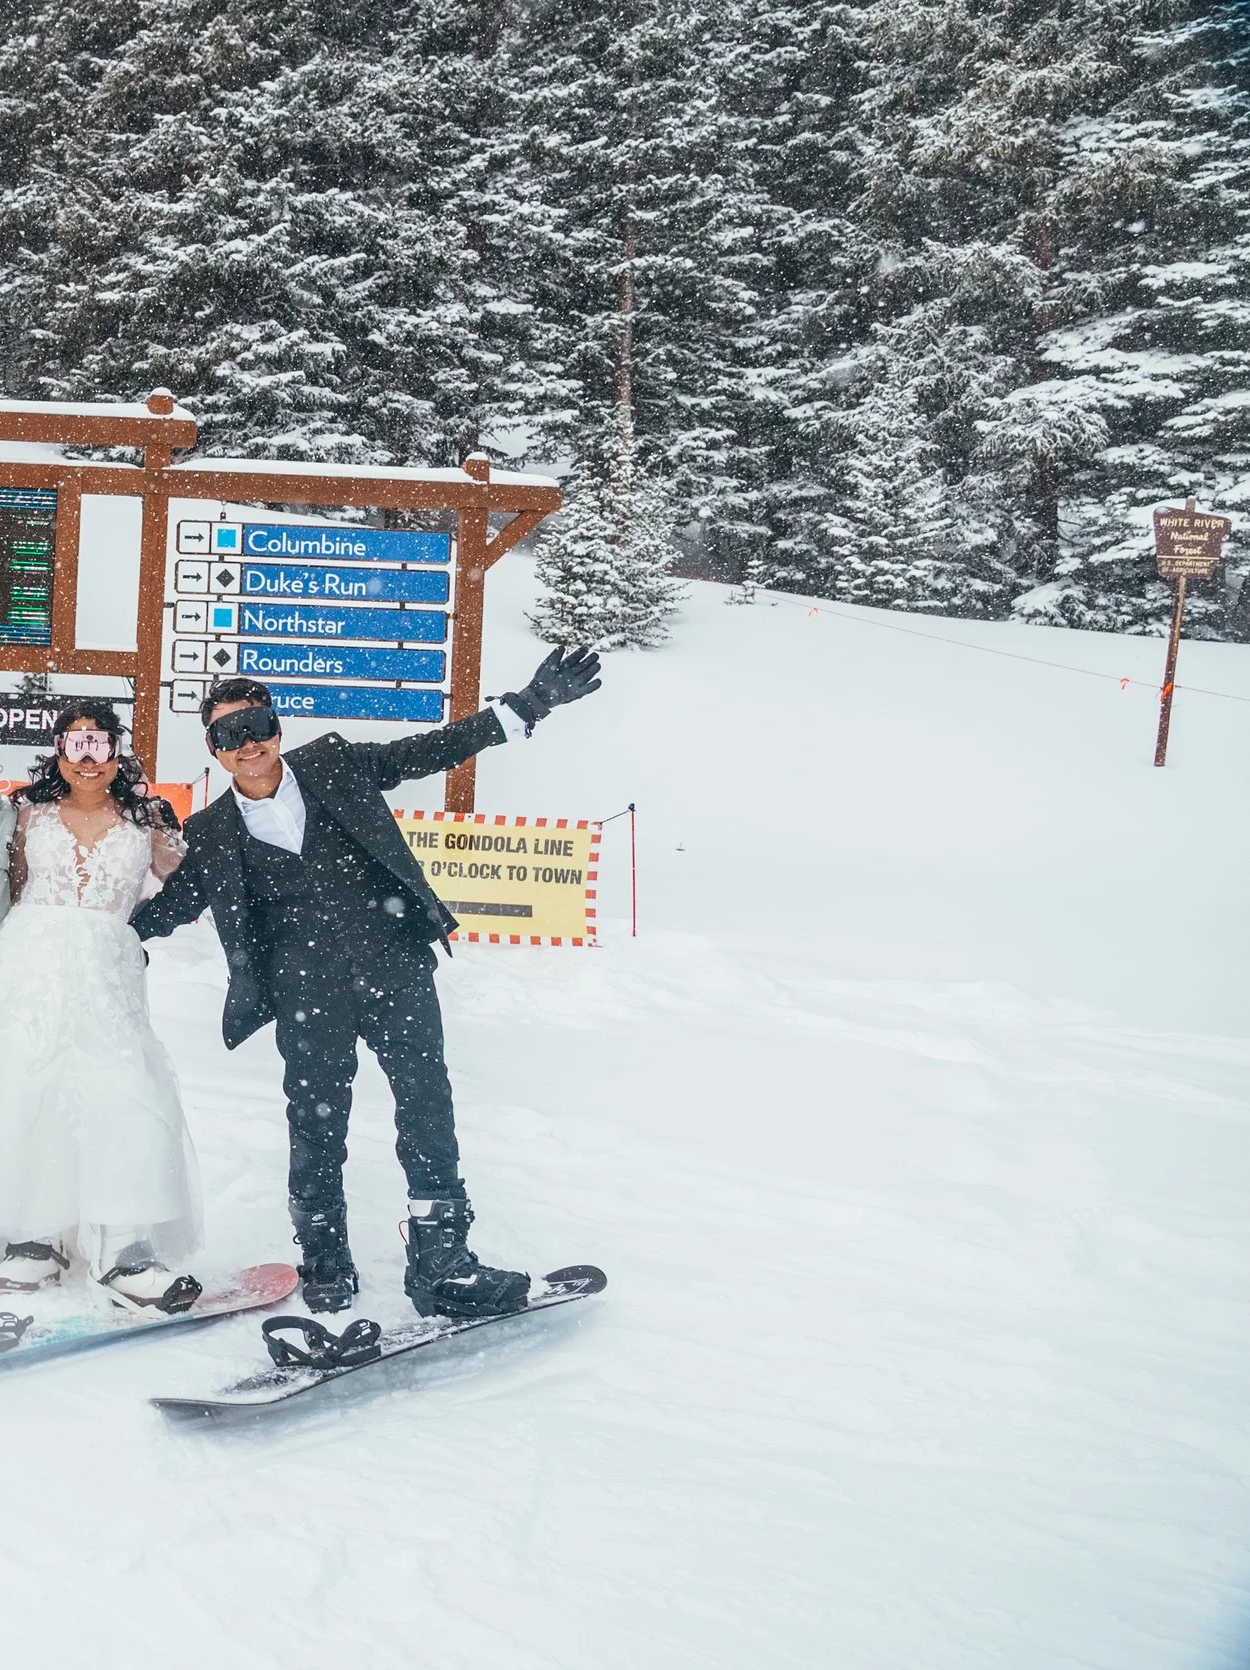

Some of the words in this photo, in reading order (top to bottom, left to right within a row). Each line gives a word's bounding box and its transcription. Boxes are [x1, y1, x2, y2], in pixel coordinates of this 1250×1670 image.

[1159, 517, 1190, 527] WHITE
[1194, 519, 1225, 529] RIVER
[248, 530, 366, 557] Columbine
[1170, 531, 1209, 541] National
[1173, 544, 1203, 555] Forest
[1173, 567, 1208, 575] AGRICULTURE
[1175, 560, 1211, 568] DEPARTMENT
[245, 570, 319, 594] Duke's
[324, 575, 366, 596] Run
[244, 610, 346, 635] Northstar
[243, 650, 344, 673] Rounders
[407, 831, 439, 849] THE
[444, 832, 528, 854] GONDOLA
[533, 838, 574, 857] LINE
[431, 860, 502, 880] O'CLOCK
[506, 865, 528, 882] TO
[532, 866, 583, 885] TOWN
